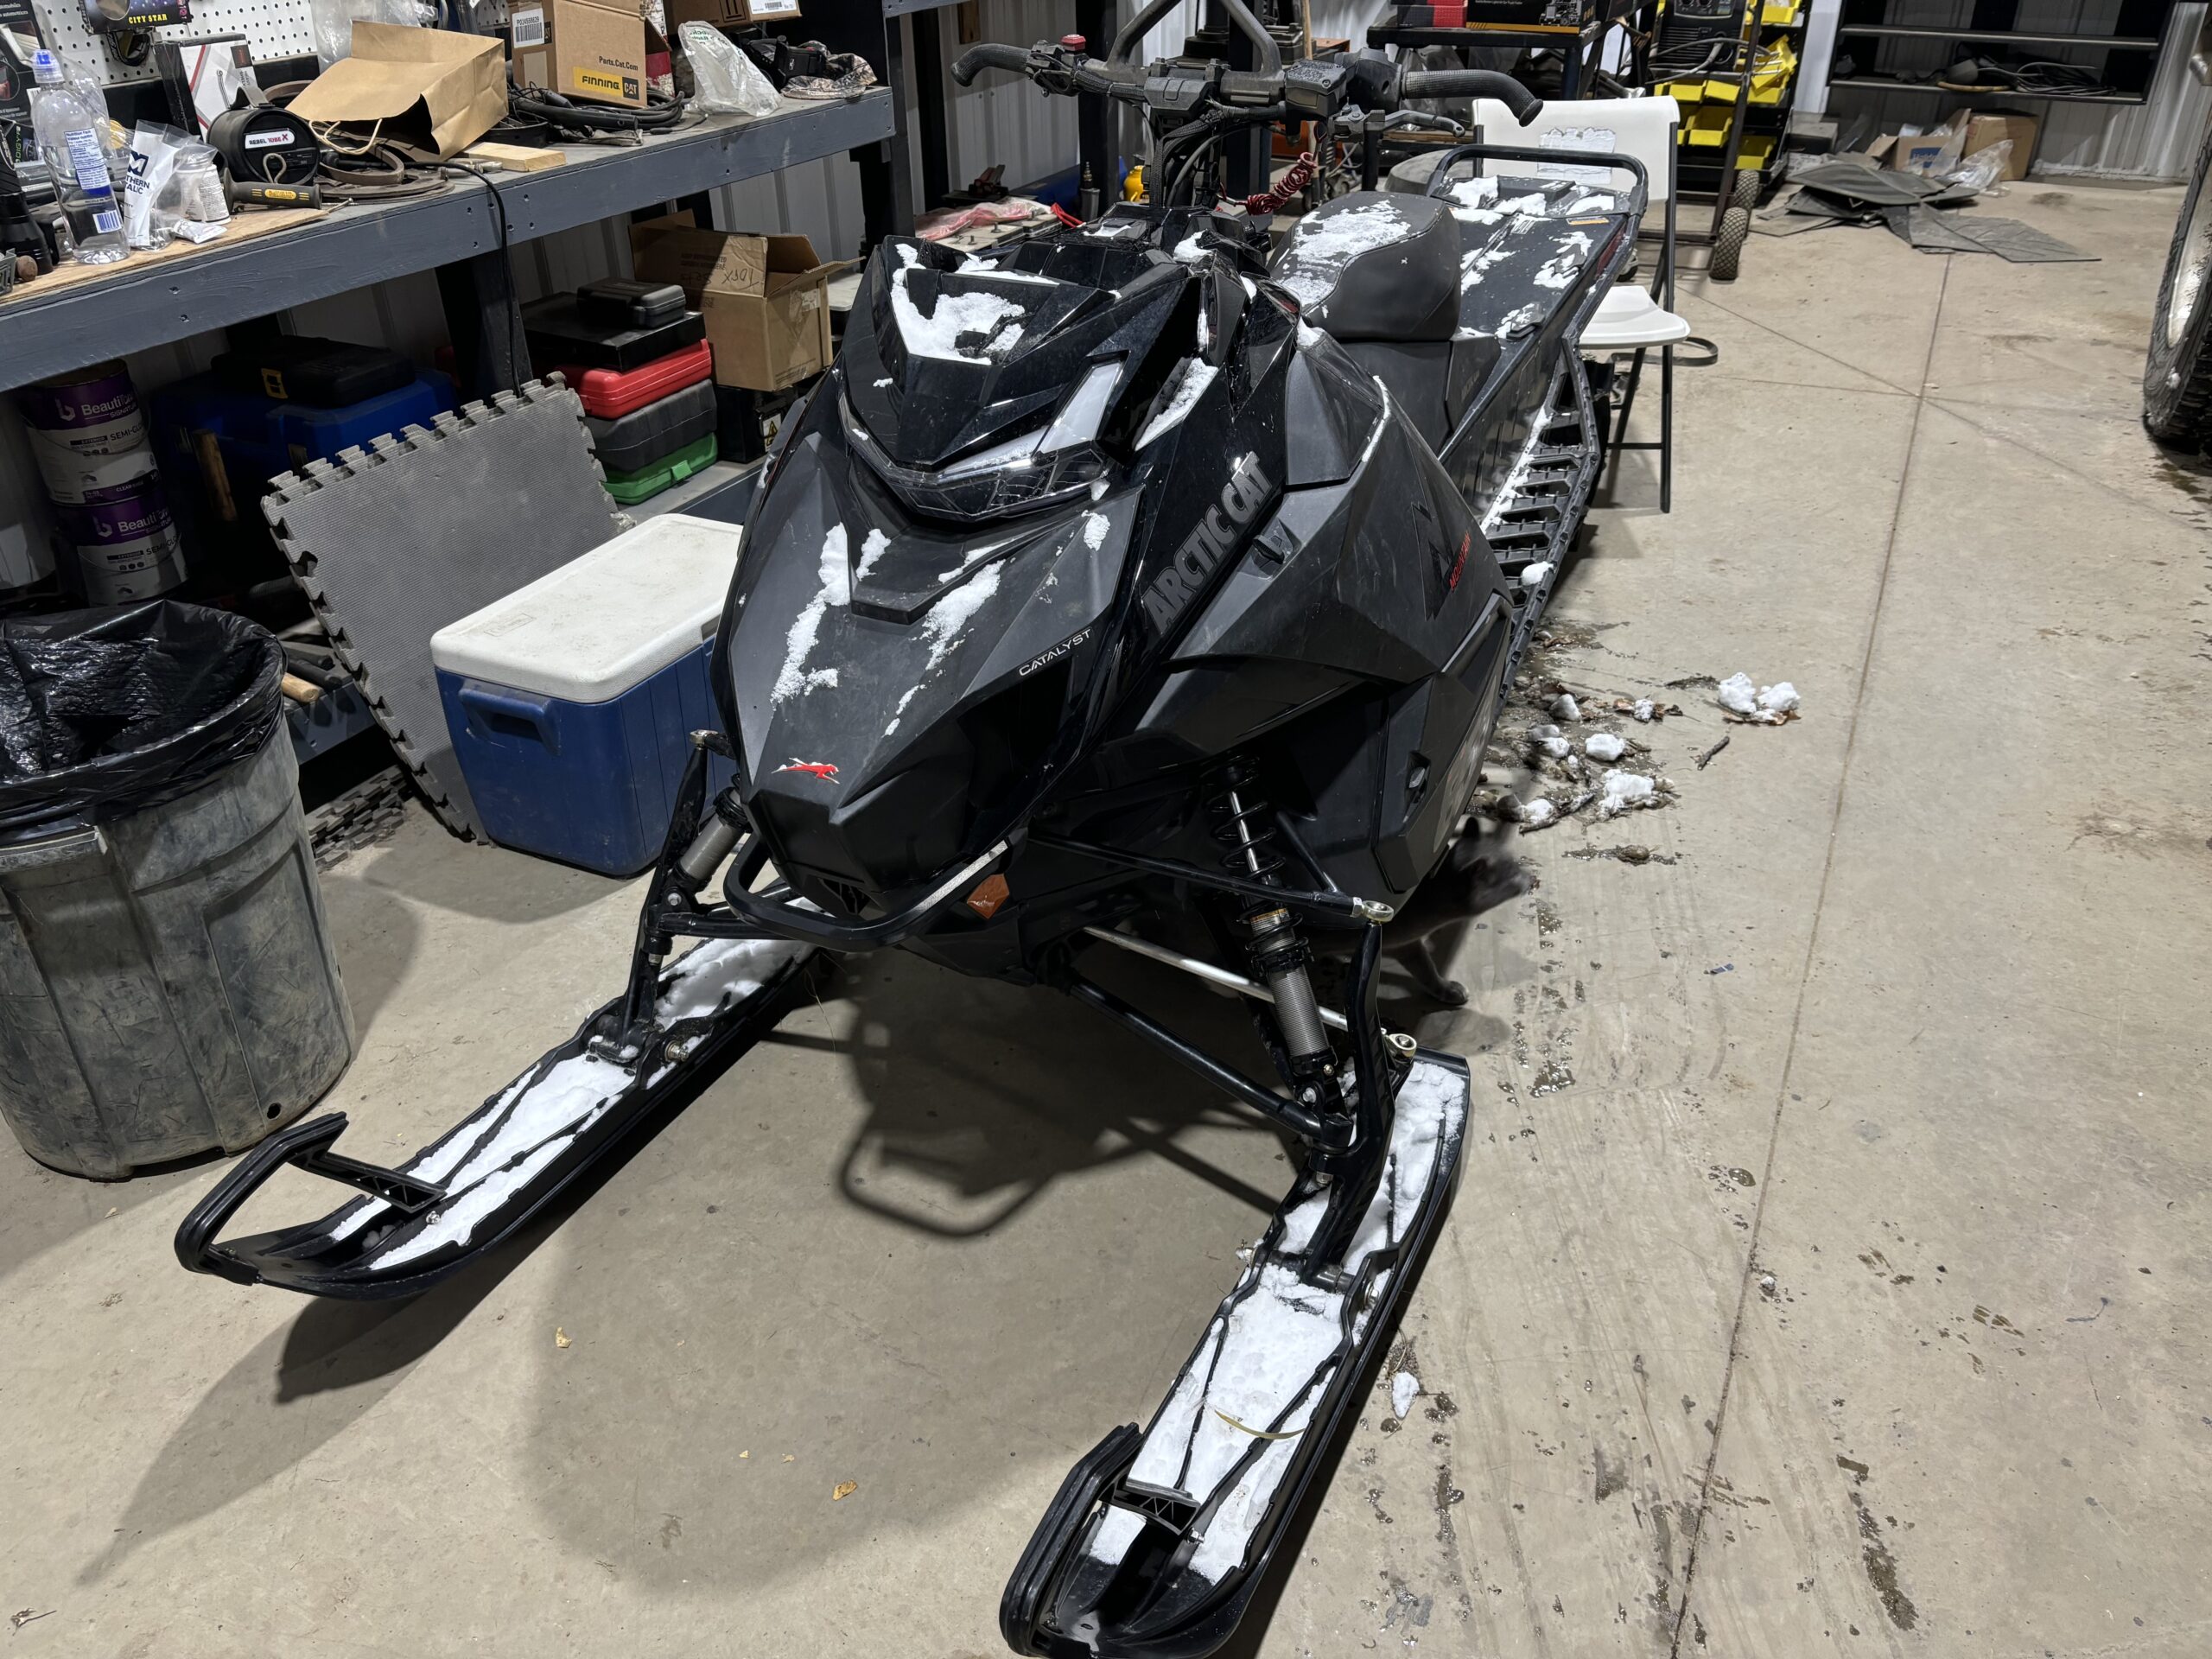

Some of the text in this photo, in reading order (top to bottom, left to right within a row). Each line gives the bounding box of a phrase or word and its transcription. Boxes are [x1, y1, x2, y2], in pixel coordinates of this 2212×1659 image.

[128, 13, 168, 24] CITY STAR
[599, 55, 639, 72] Parts.Cat.Com
[582, 75, 620, 90] FINNING
[624, 82, 638, 95] CAT
[125, 175, 150, 189] THERN
[125, 183, 143, 194] ALIC
[1141, 451, 1272, 638] ARCTIC CAT
[1019, 628, 1091, 677] CATALYST
